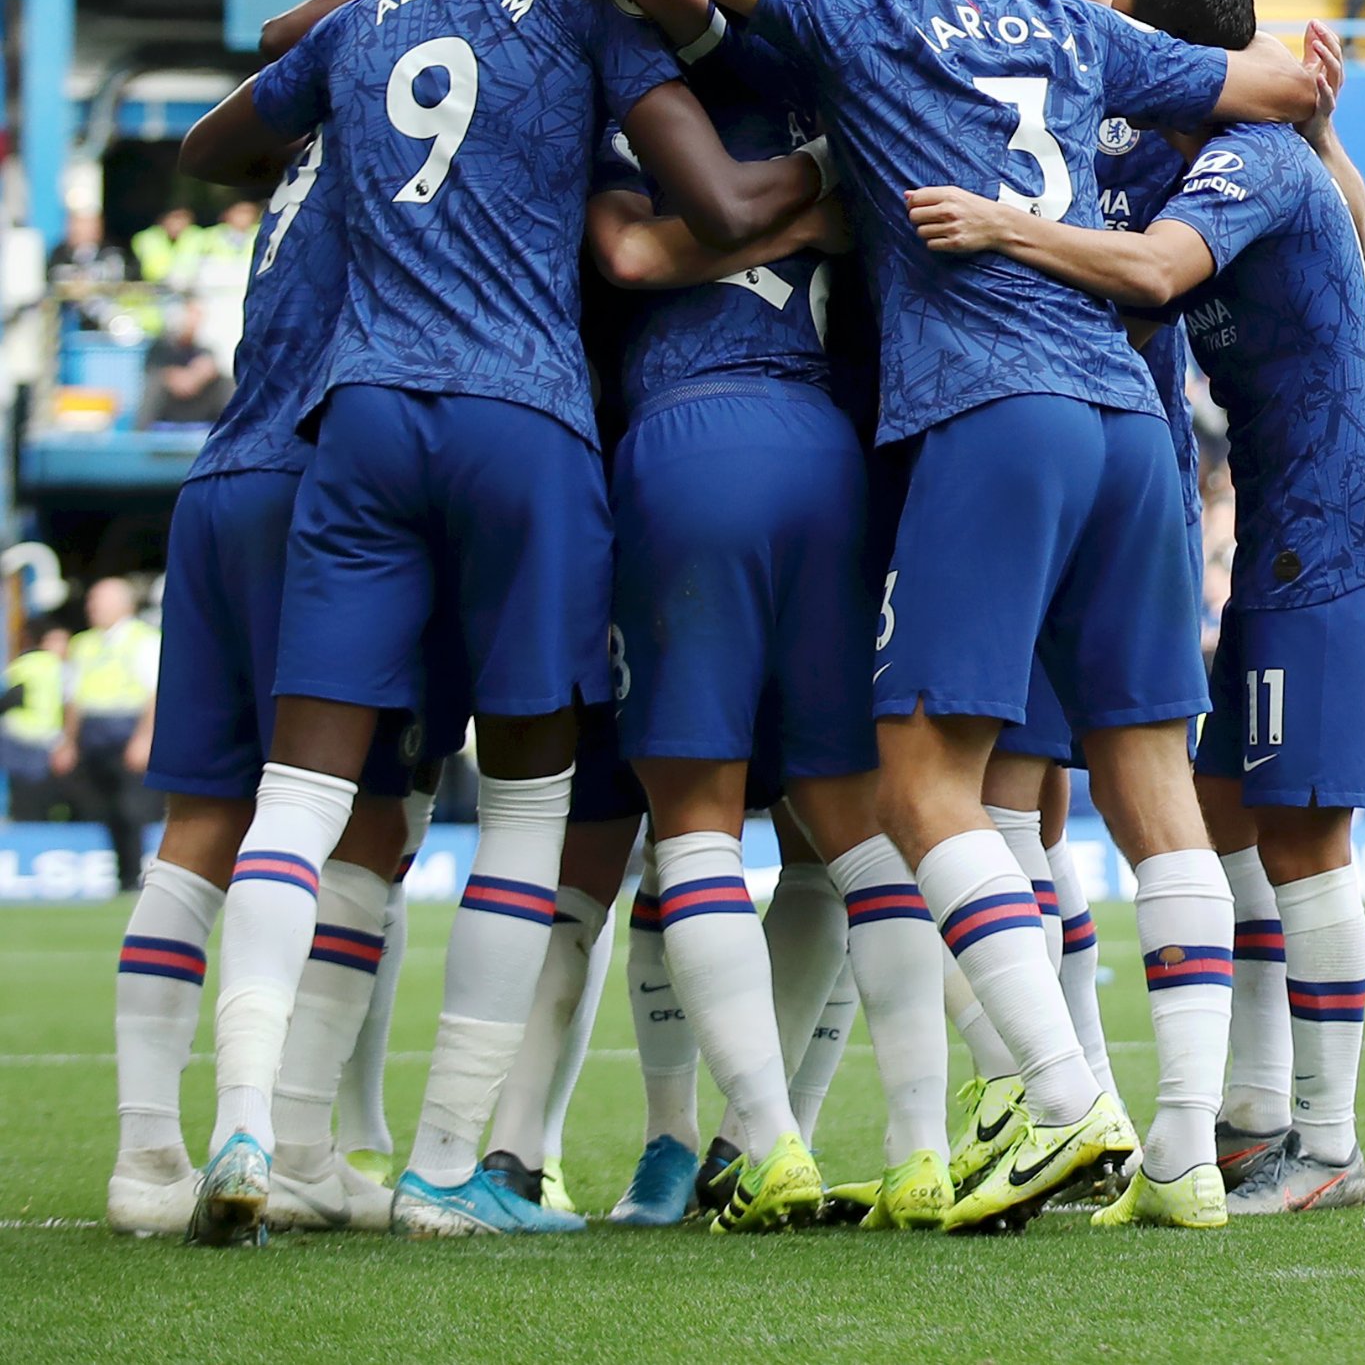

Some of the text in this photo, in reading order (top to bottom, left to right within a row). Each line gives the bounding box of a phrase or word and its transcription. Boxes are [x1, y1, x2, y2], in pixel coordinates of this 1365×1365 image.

[386, 36, 479, 203] 9
[972, 76, 1074, 222] 3
[1246, 668, 1285, 746] 11
[649, 1007, 687, 1023] CFC
